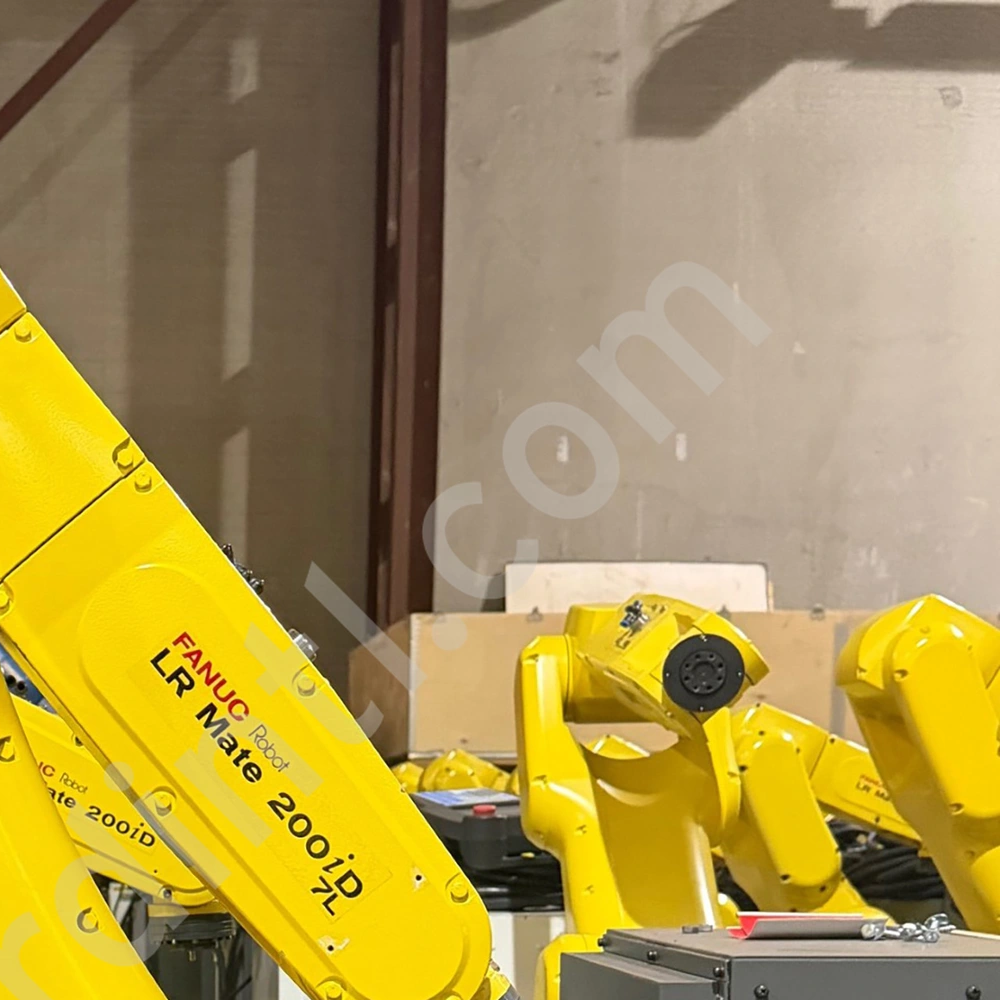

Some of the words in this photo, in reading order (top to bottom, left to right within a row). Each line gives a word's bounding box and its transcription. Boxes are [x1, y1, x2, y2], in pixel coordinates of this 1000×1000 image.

[172, 632, 249, 722] FANUC
[249, 724, 290, 773] Robot
[60, 772, 88, 795] Robot
[150, 648, 195, 699] LR
[195, 702, 262, 783] Mate
[267, 792, 363, 899] 200iD
[46, 784, 76, 809] ate
[85, 804, 155, 847] 200iD
[311, 876, 338, 916] 7L
